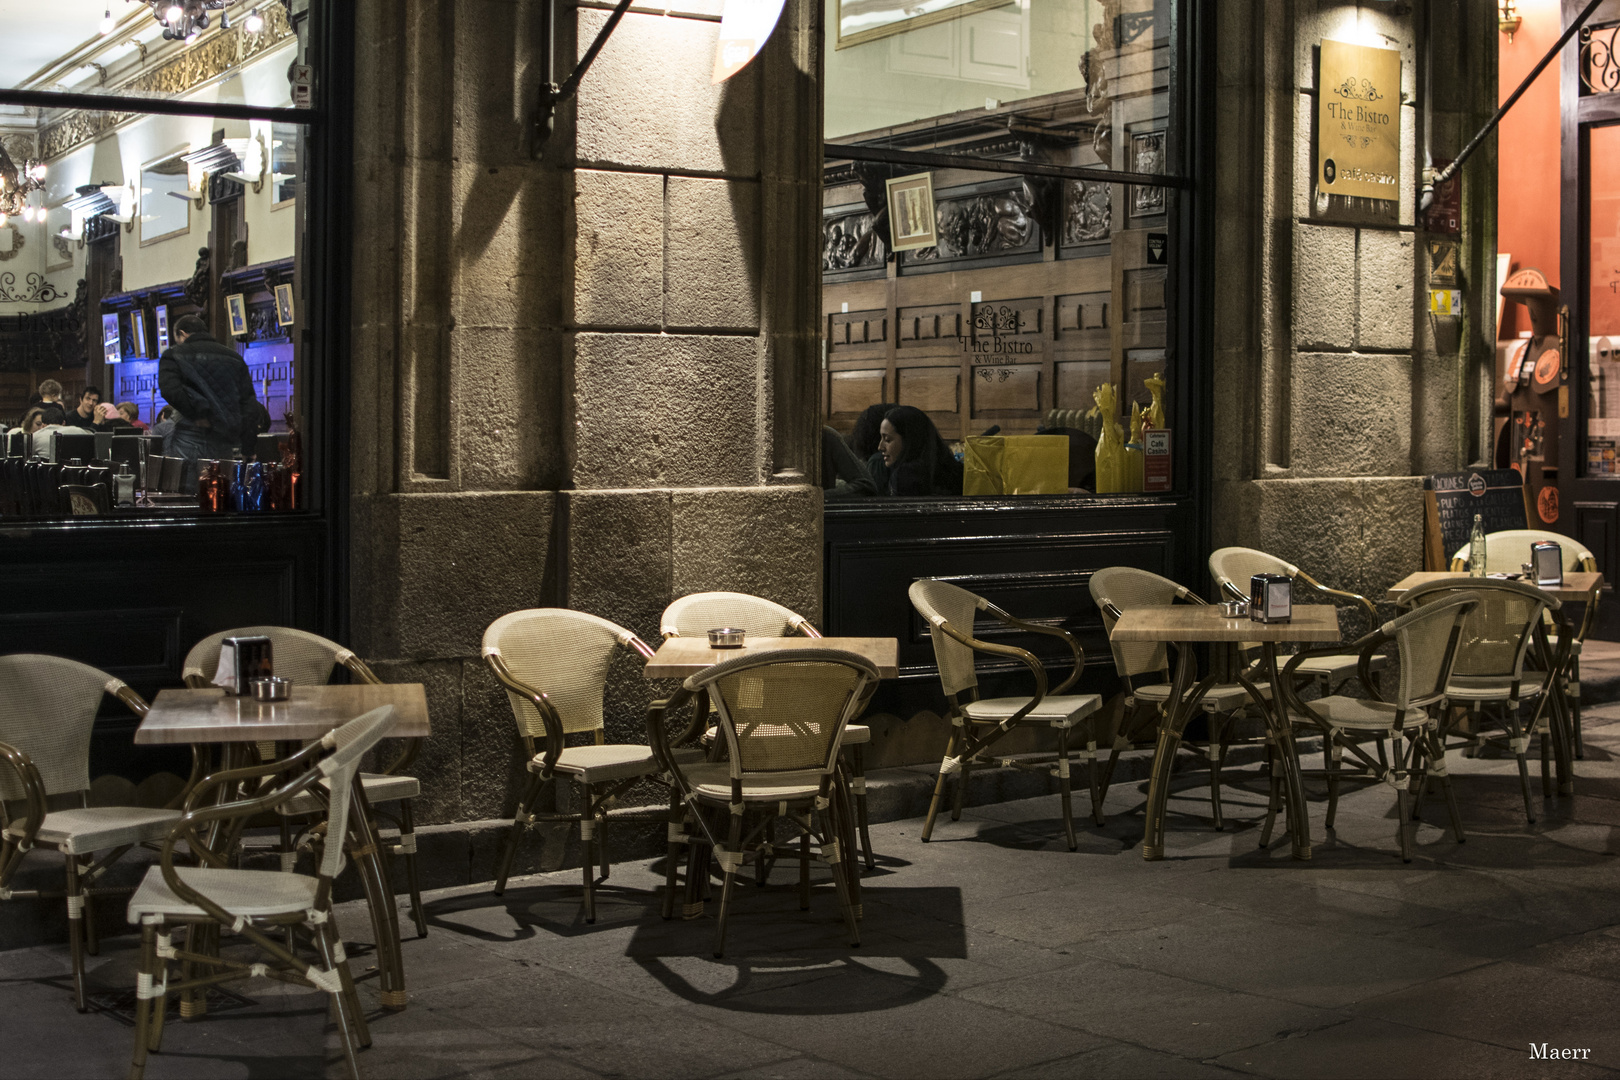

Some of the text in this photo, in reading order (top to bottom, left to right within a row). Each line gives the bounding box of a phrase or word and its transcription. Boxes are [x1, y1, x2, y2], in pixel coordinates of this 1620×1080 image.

[1328, 102, 1389, 125] The Bistro
[1340, 121, 1346, 130] &
[1340, 167, 1395, 184] café casino
[17, 311, 80, 332] Bistro
[958, 334, 1033, 354] The Bistro
[974, 355, 1017, 364] & Wine Bar
[1147, 447, 1167, 455] Casino
[1441, 497, 1465, 509] PULPO
[1442, 508, 1469, 519] PLATOS
